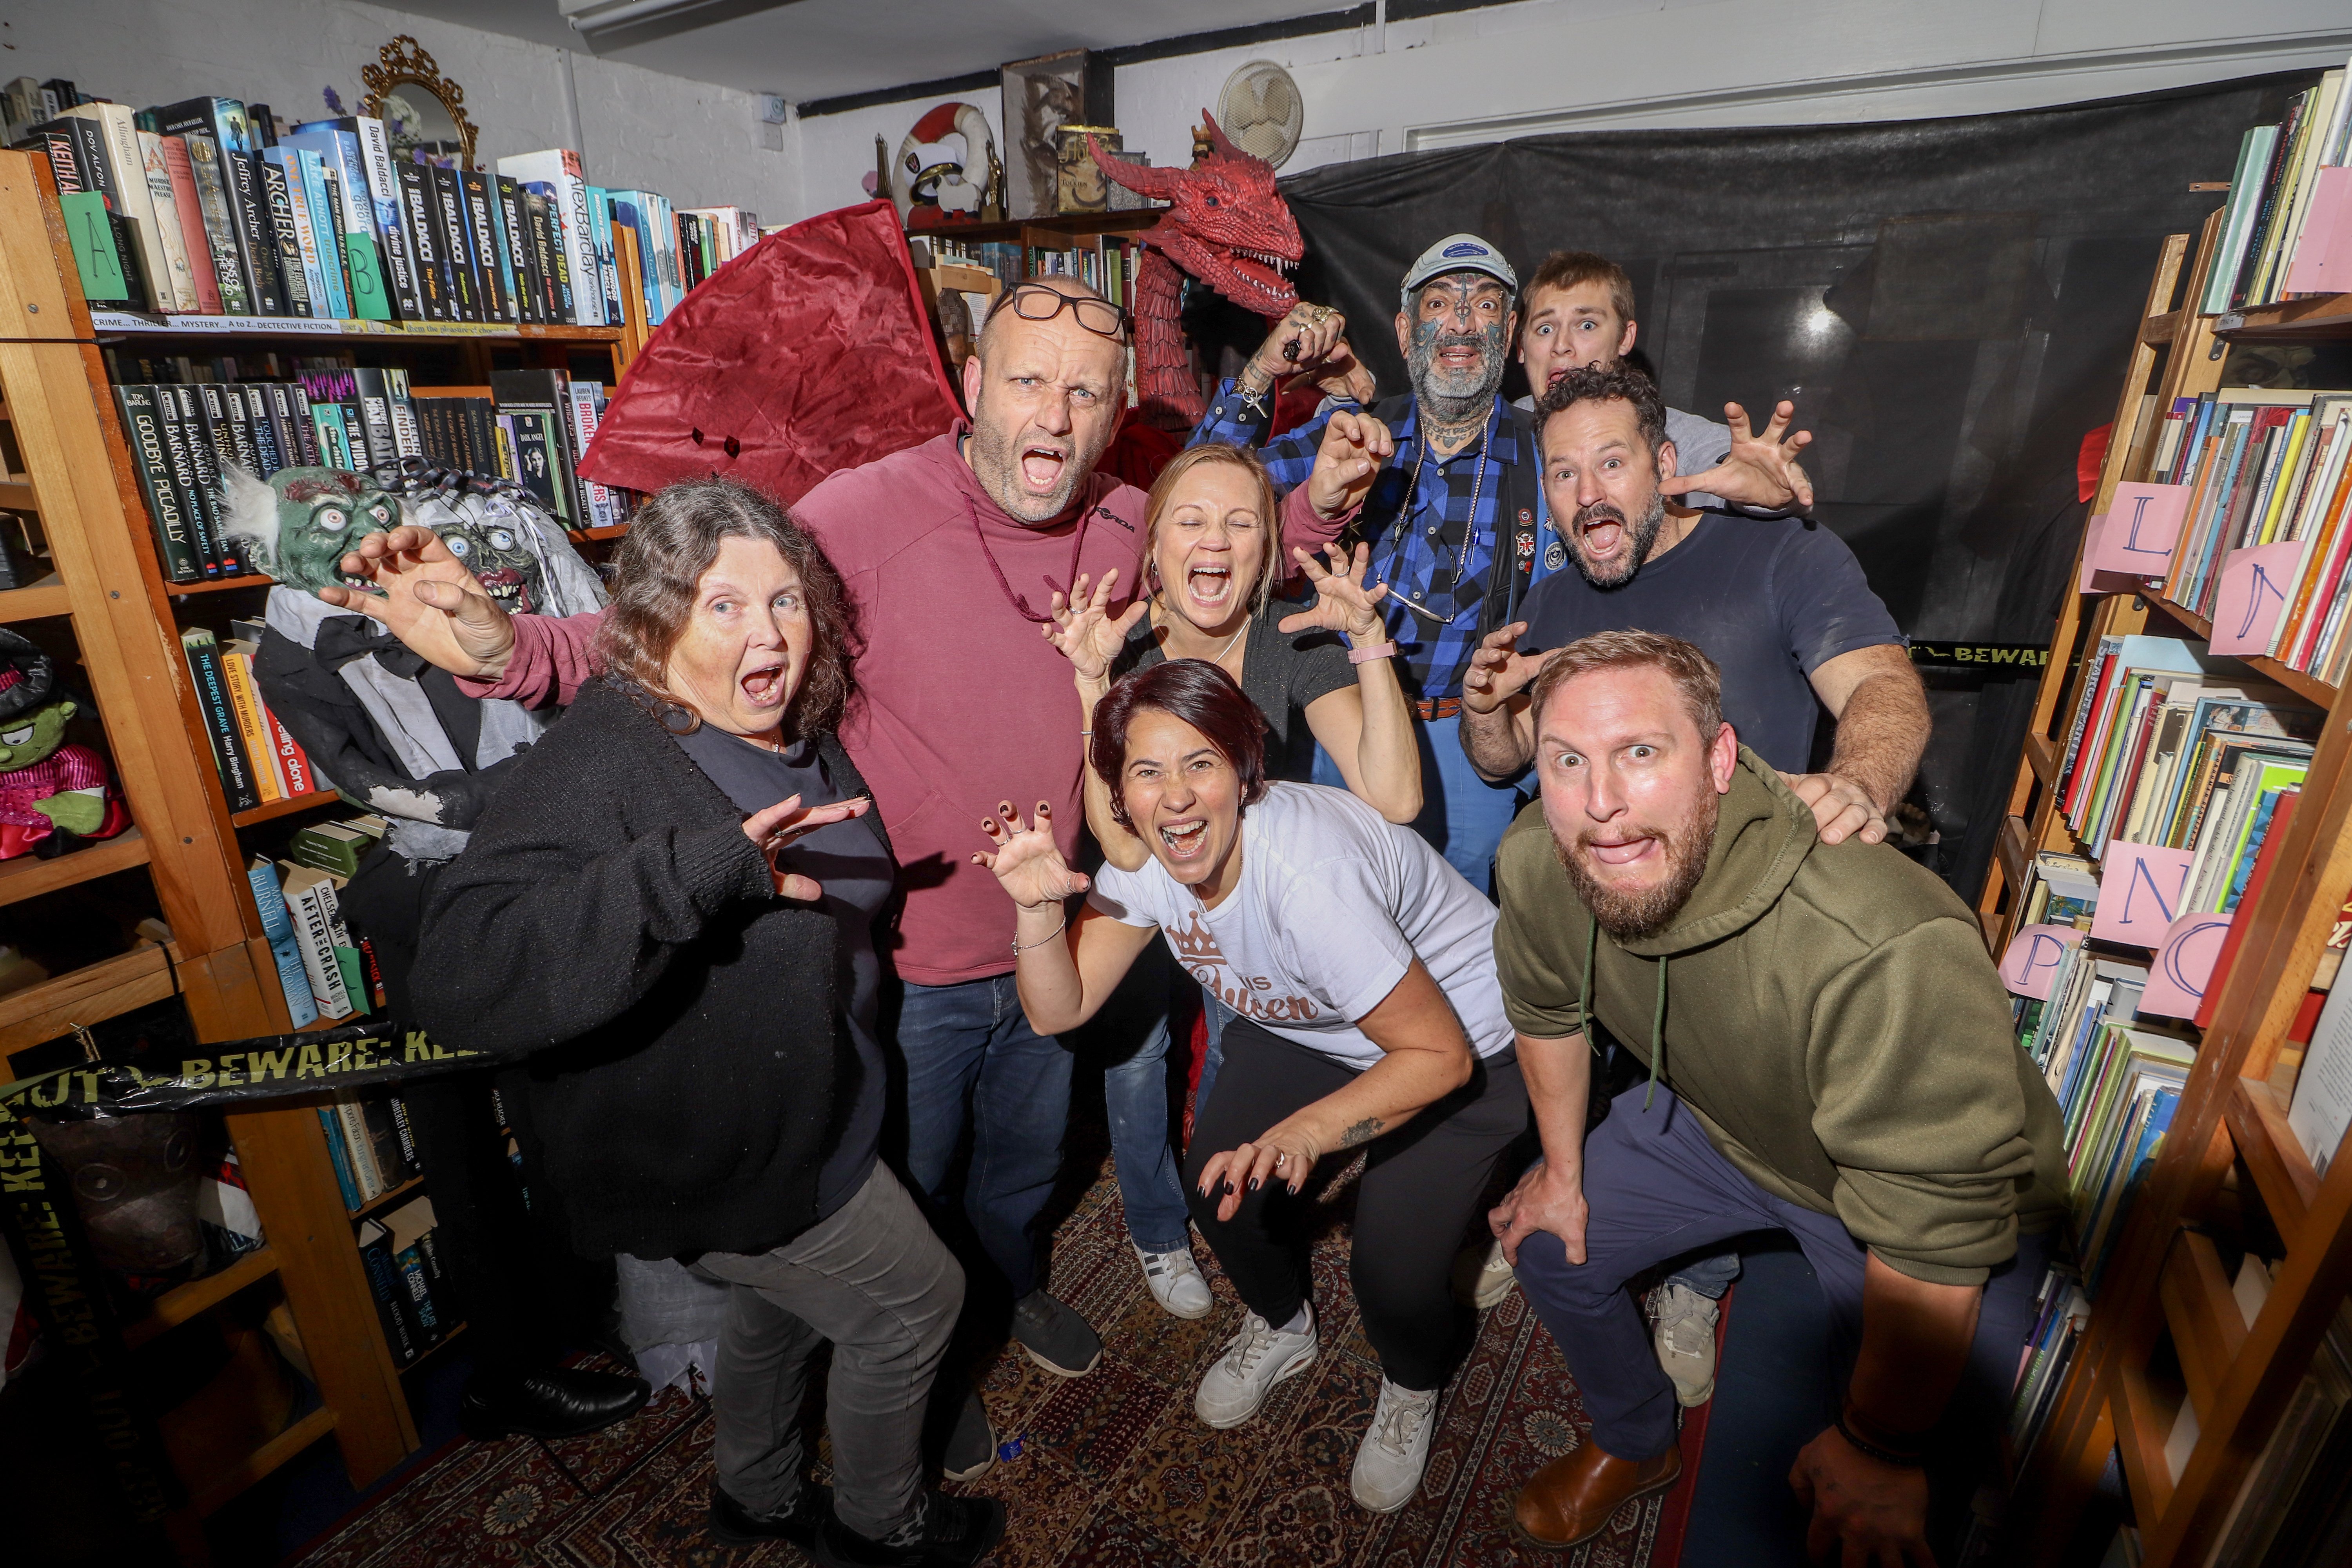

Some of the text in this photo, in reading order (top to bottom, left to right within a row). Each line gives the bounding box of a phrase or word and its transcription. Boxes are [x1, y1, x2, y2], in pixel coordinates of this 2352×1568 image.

[49, 140, 79, 180] KEITH
[85, 130, 106, 187] DOV ALFON
[116, 117, 134, 166] Allingham
[343, 140, 358, 183] BADENOCH
[368, 125, 392, 197] David Baldacci
[264, 166, 294, 240] ARCHER
[307, 158, 330, 236] JAKE ARNOTT
[1060, 179, 1088, 188] TOLKIEN
[244, 198, 260, 241] Archer
[286, 155, 316, 263] ONE TRUE WORD
[360, 189, 371, 225] LOVING
[408, 191, 434, 263] BALDACCI
[593, 193, 610, 262] BROKEN PROMISE
[85, 211, 116, 279] A
[442, 197, 465, 265] BALDACCI
[471, 202, 495, 268] BALDACCI
[503, 203, 525, 269] BALDACCI
[533, 216, 551, 277] David Baldacci
[548, 203, 568, 283] PERFECT DEAD
[749, 221, 757, 241] CITY
[1466, 243, 1486, 252] ARMY
[2250, 200, 2270, 258] NEIL ASTLEY
[113, 227, 133, 282] LONG NIGHT
[217, 254, 234, 296] THE DEAD
[226, 257, 241, 292] SINS OF
[248, 241, 263, 290] Dead Body
[260, 247, 273, 286] Over My
[324, 239, 339, 292] truecrime
[350, 248, 374, 295] B
[388, 225, 409, 289] divine justice
[670, 254, 679, 286] Departed
[296, 269, 309, 302] ELEVENTH
[601, 264, 612, 302] BARCLAY
[608, 264, 618, 302] LINWOOD
[93, 318, 130, 327] CRIME...
[132, 319, 180, 328] THRILLER...
[181, 320, 227, 328] MYSTERY...
[303, 323, 338, 331] FICTION...
[406, 324, 425, 333] them
[439, 324, 469, 335] pleasure
[346, 421, 360, 438] THE
[364, 397, 383, 425] MAN
[376, 397, 389, 425] MYSTERY
[564, 402, 577, 436] WHISPERS
[184, 423, 211, 485] BARNARD
[254, 427, 272, 471] THE DEAD
[261, 419, 278, 461] TOUCHED
[300, 424, 309, 443] THE
[328, 427, 344, 470] the child
[519, 433, 545, 442] DARK ANGEL
[165, 424, 193, 488] BARNARD
[135, 414, 187, 544] GOODBYE PICCADILLY
[579, 485, 588, 512] BECKETT
[207, 487, 218, 515] THE BAD
[190, 500, 211, 555] PLACE SAFETY
[200, 653, 230, 734] THE DEEPEST GRAVE
[225, 659, 254, 738] LOVE WITH MURDERS
[2069, 646, 2106, 760] SEARCH PARTY
[223, 735, 245, 789] Harry Bingham
[254, 759, 268, 784] BINGHAM
[287, 757, 305, 792] alone
[2233, 768, 2242, 789] Silver
[2194, 752, 2222, 837] SUBHUMAN REDNECK
[2227, 789, 2236, 804] bells
[2092, 829, 2101, 853] CARCANET
[2213, 819, 2223, 842] cockle
[2207, 843, 2216, 863] shells
[2118, 857, 2190, 924] N
[2200, 870, 2208, 884] Eva
[251, 873, 280, 933] BURNELL
[269, 884, 287, 913] MARK
[301, 896, 324, 938] AFTER
[315, 938, 328, 947] THE
[2014, 934, 2065, 985] P
[279, 965, 302, 1007] WOMAN
[289, 956, 312, 1009] THE THIRD
[318, 946, 341, 991] CRASH
[330, 990, 346, 1000] MICHEL
[333, 995, 346, 1004] BUSSI
[182, 1040, 391, 1091] BEWARE:
[493, 1089, 506, 1126] JACK REACHER
[399, 1129, 414, 1162] CHAMBERS
[407, 1272, 421, 1302] CONNELLY
[413, 1269, 428, 1297] MICHAEL
[390, 1300, 410, 1349] BLOOD WORK
[418, 1309, 428, 1328] SHOW
[428, 1310, 437, 1327] LATE
